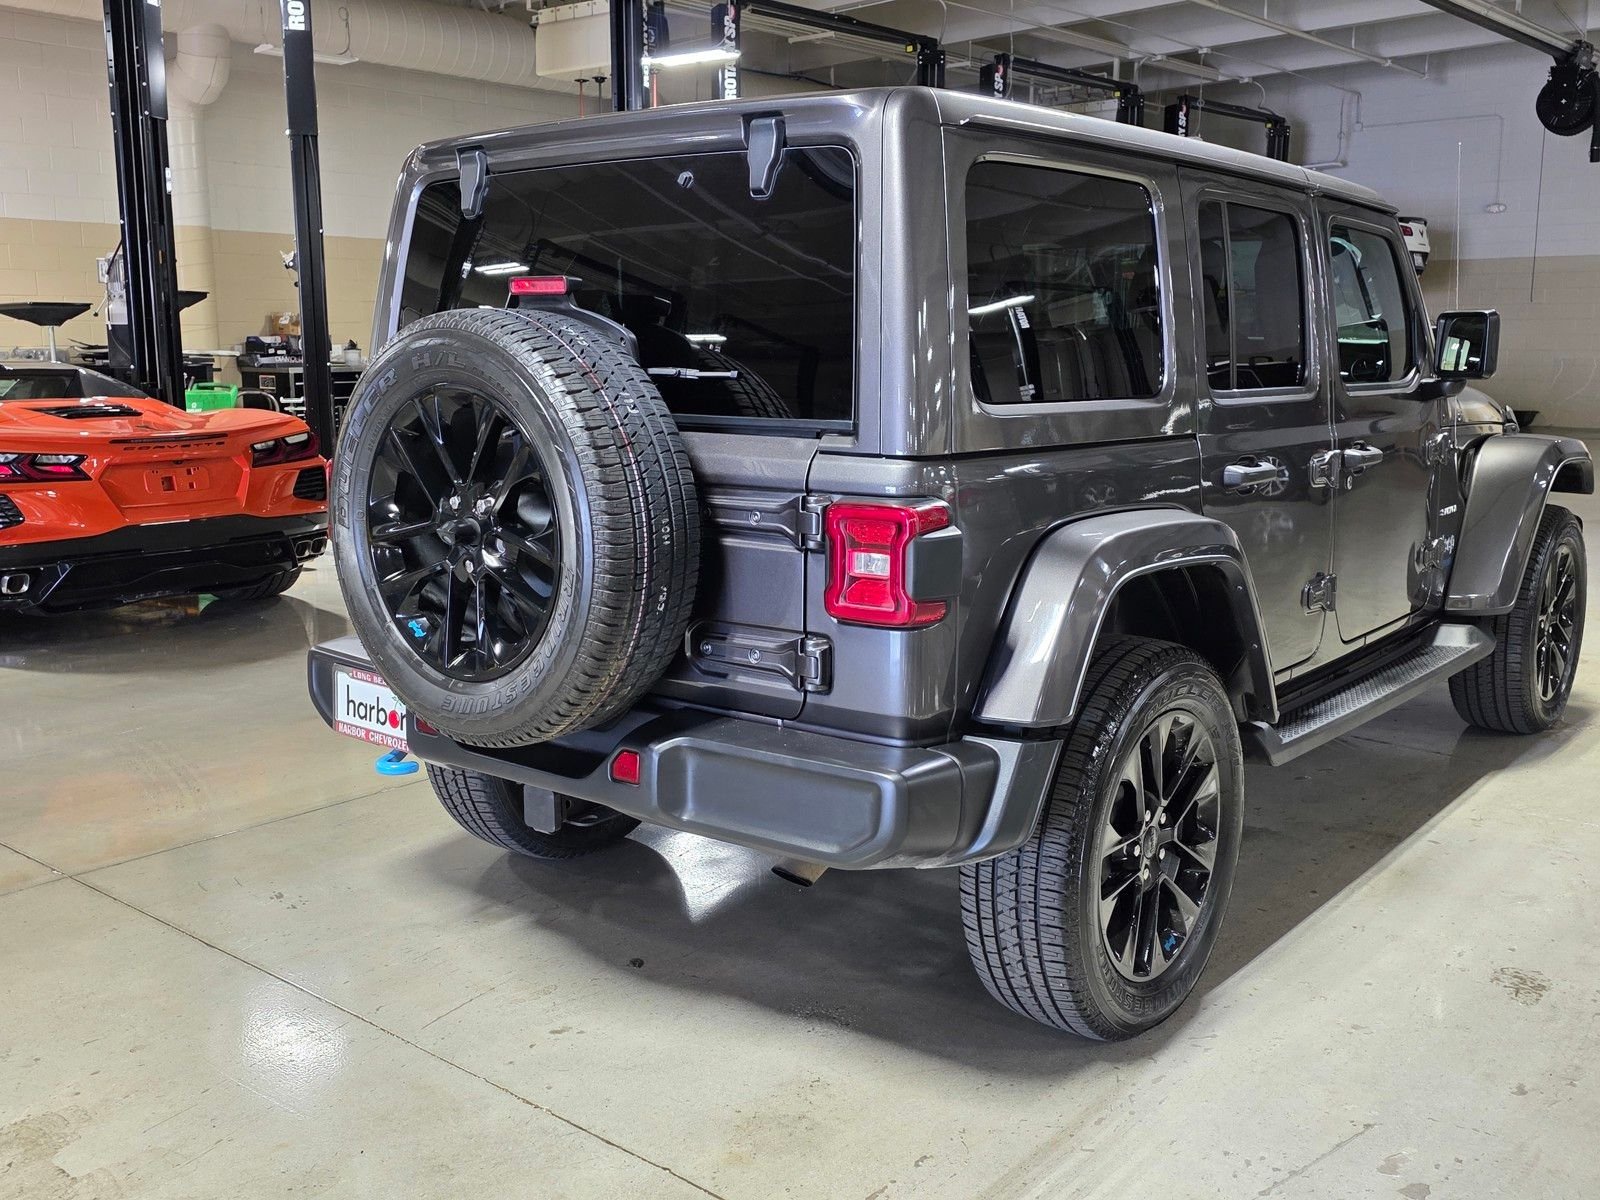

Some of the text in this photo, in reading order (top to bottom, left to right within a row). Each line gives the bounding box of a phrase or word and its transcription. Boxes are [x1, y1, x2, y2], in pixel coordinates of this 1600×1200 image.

[123, 441, 225, 451] CORVETTE
[337, 367, 398, 529] DUELER
[411, 350, 466, 369] H/L
[441, 561, 576, 715] BRIDGESTONE
[353, 670, 371, 682] LONG
[346, 684, 407, 731] harbor
[338, 722, 367, 740] HARBOR
